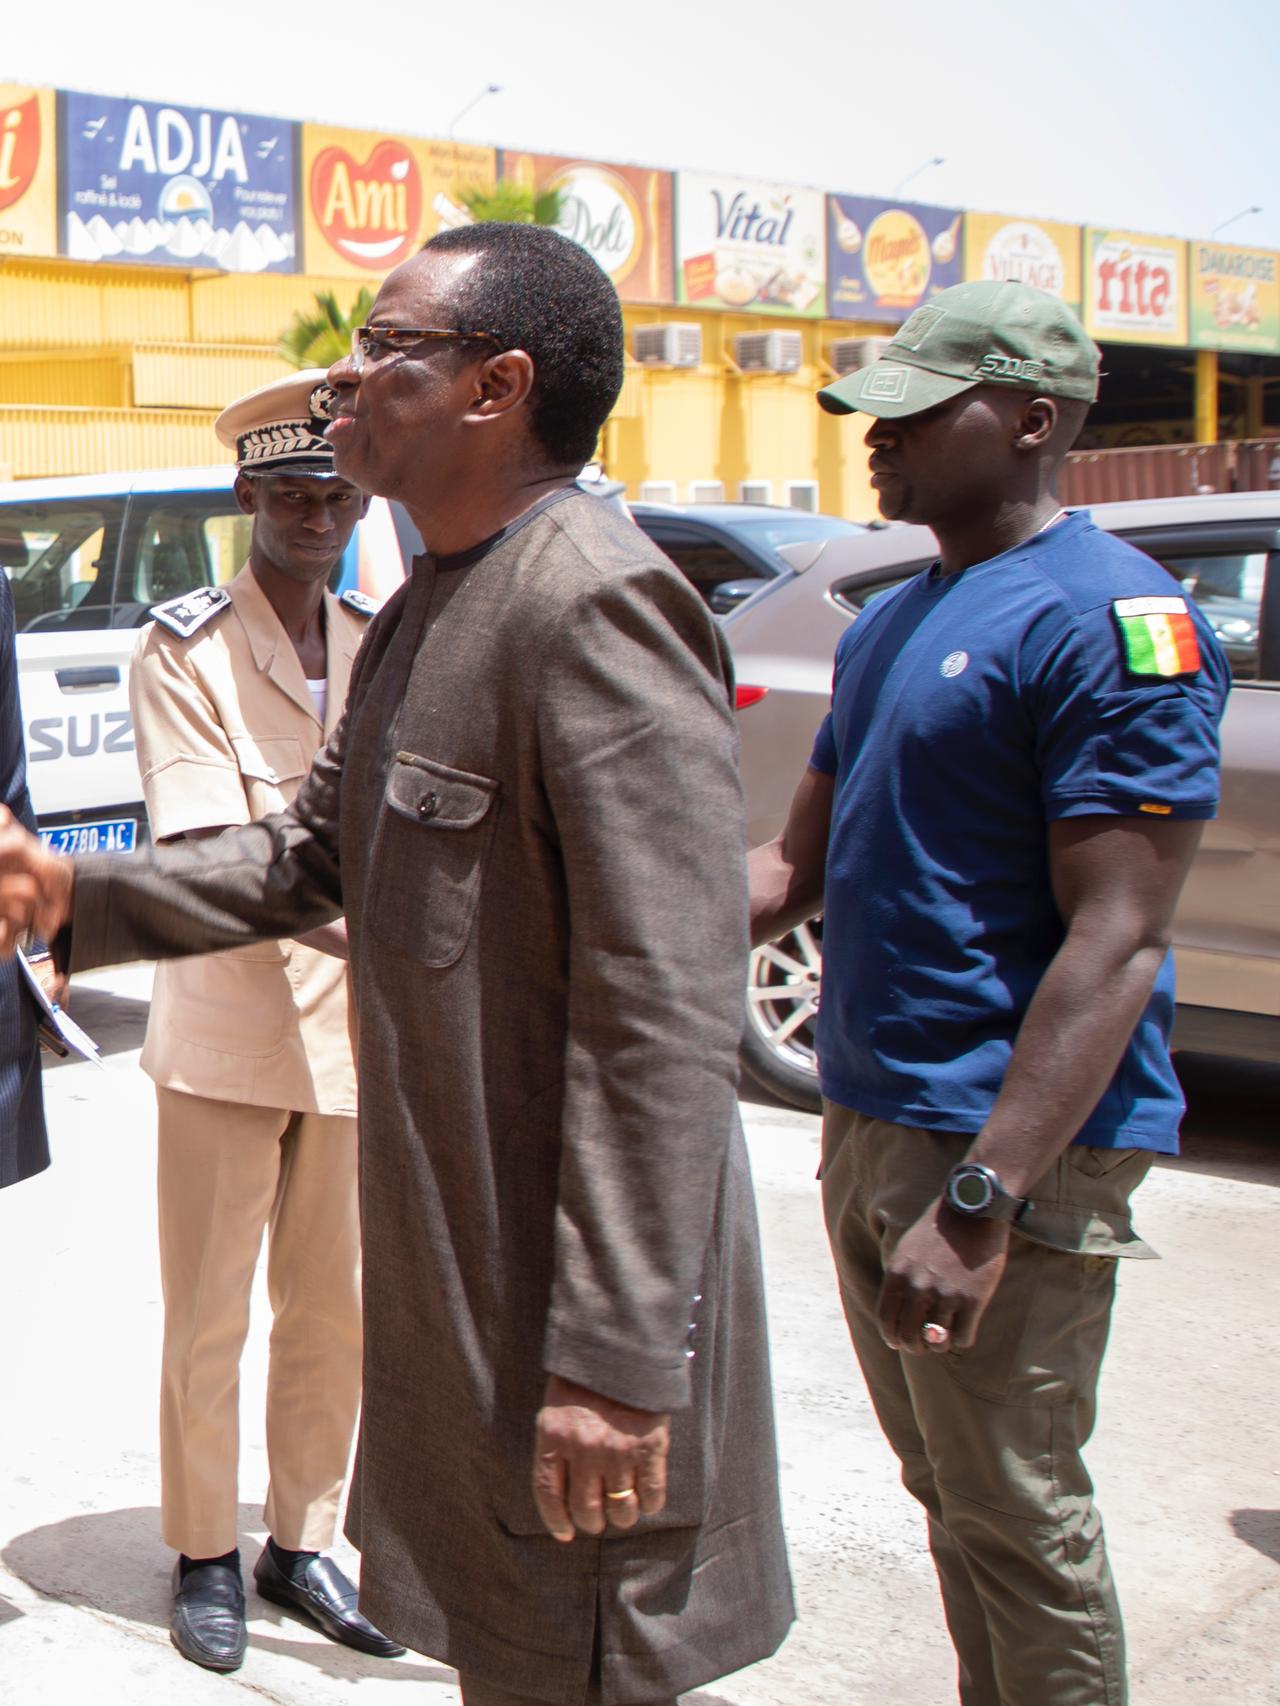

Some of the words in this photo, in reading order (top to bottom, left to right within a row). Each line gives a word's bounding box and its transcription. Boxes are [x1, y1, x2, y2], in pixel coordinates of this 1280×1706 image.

[119, 104, 249, 184] ADJA
[323, 159, 410, 232] Ami
[561, 194, 629, 253] Doli
[710, 188, 795, 246] Vital
[1099, 248, 1170, 317] rita
